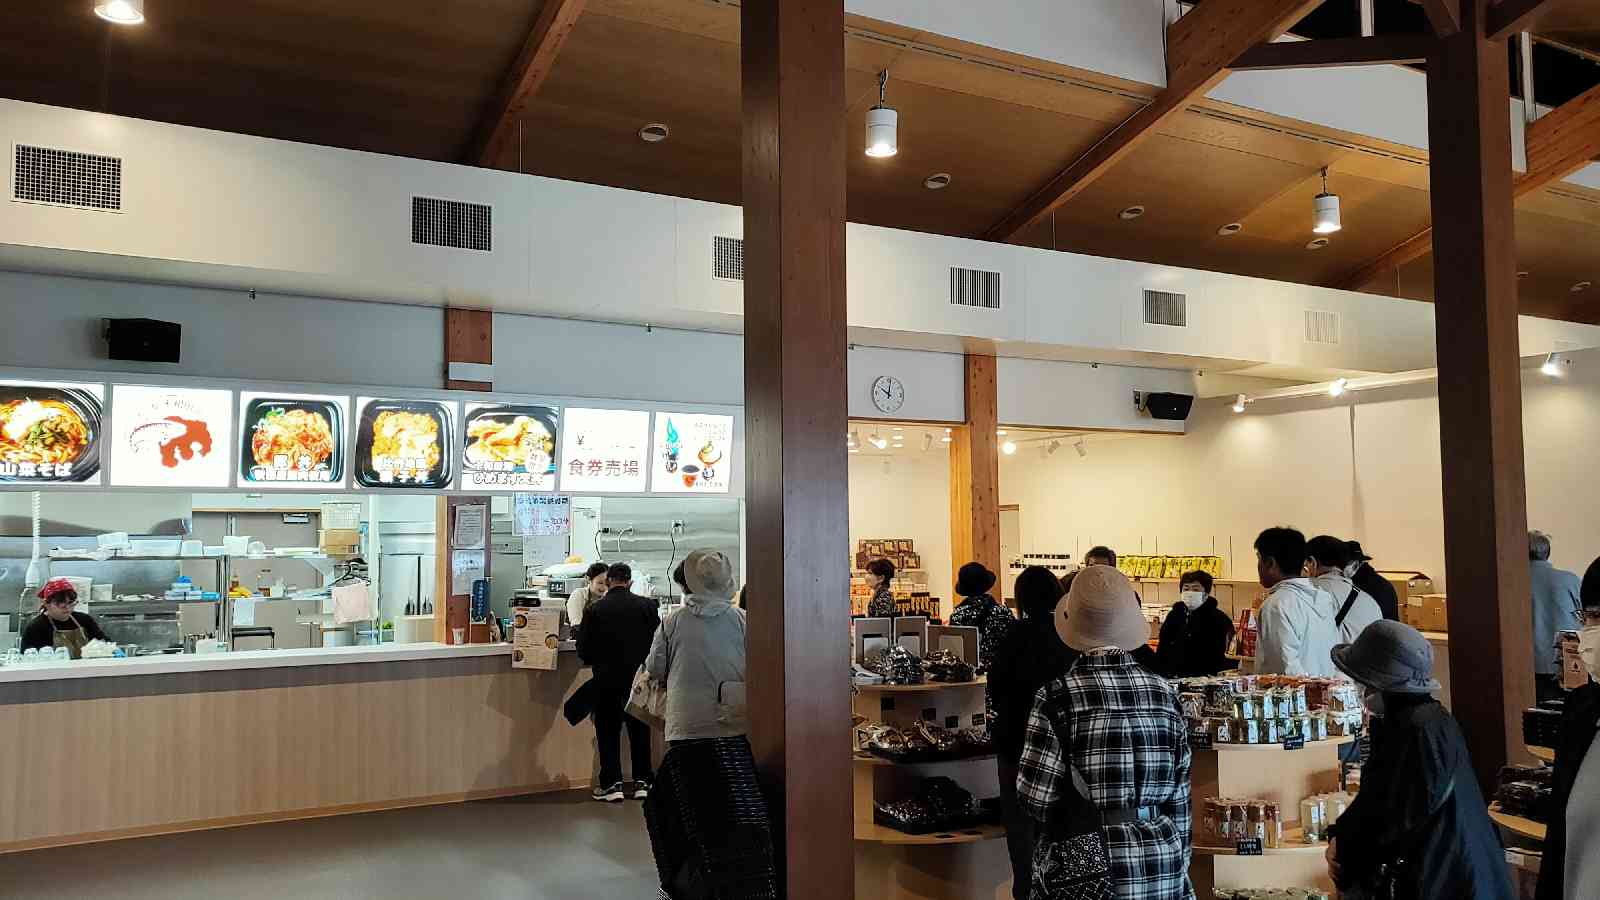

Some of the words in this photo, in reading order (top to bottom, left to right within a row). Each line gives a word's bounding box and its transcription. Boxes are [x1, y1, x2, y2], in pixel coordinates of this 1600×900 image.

[0, 461, 72, 477] 山菜そば
[567, 458, 640, 477] 食券売場
